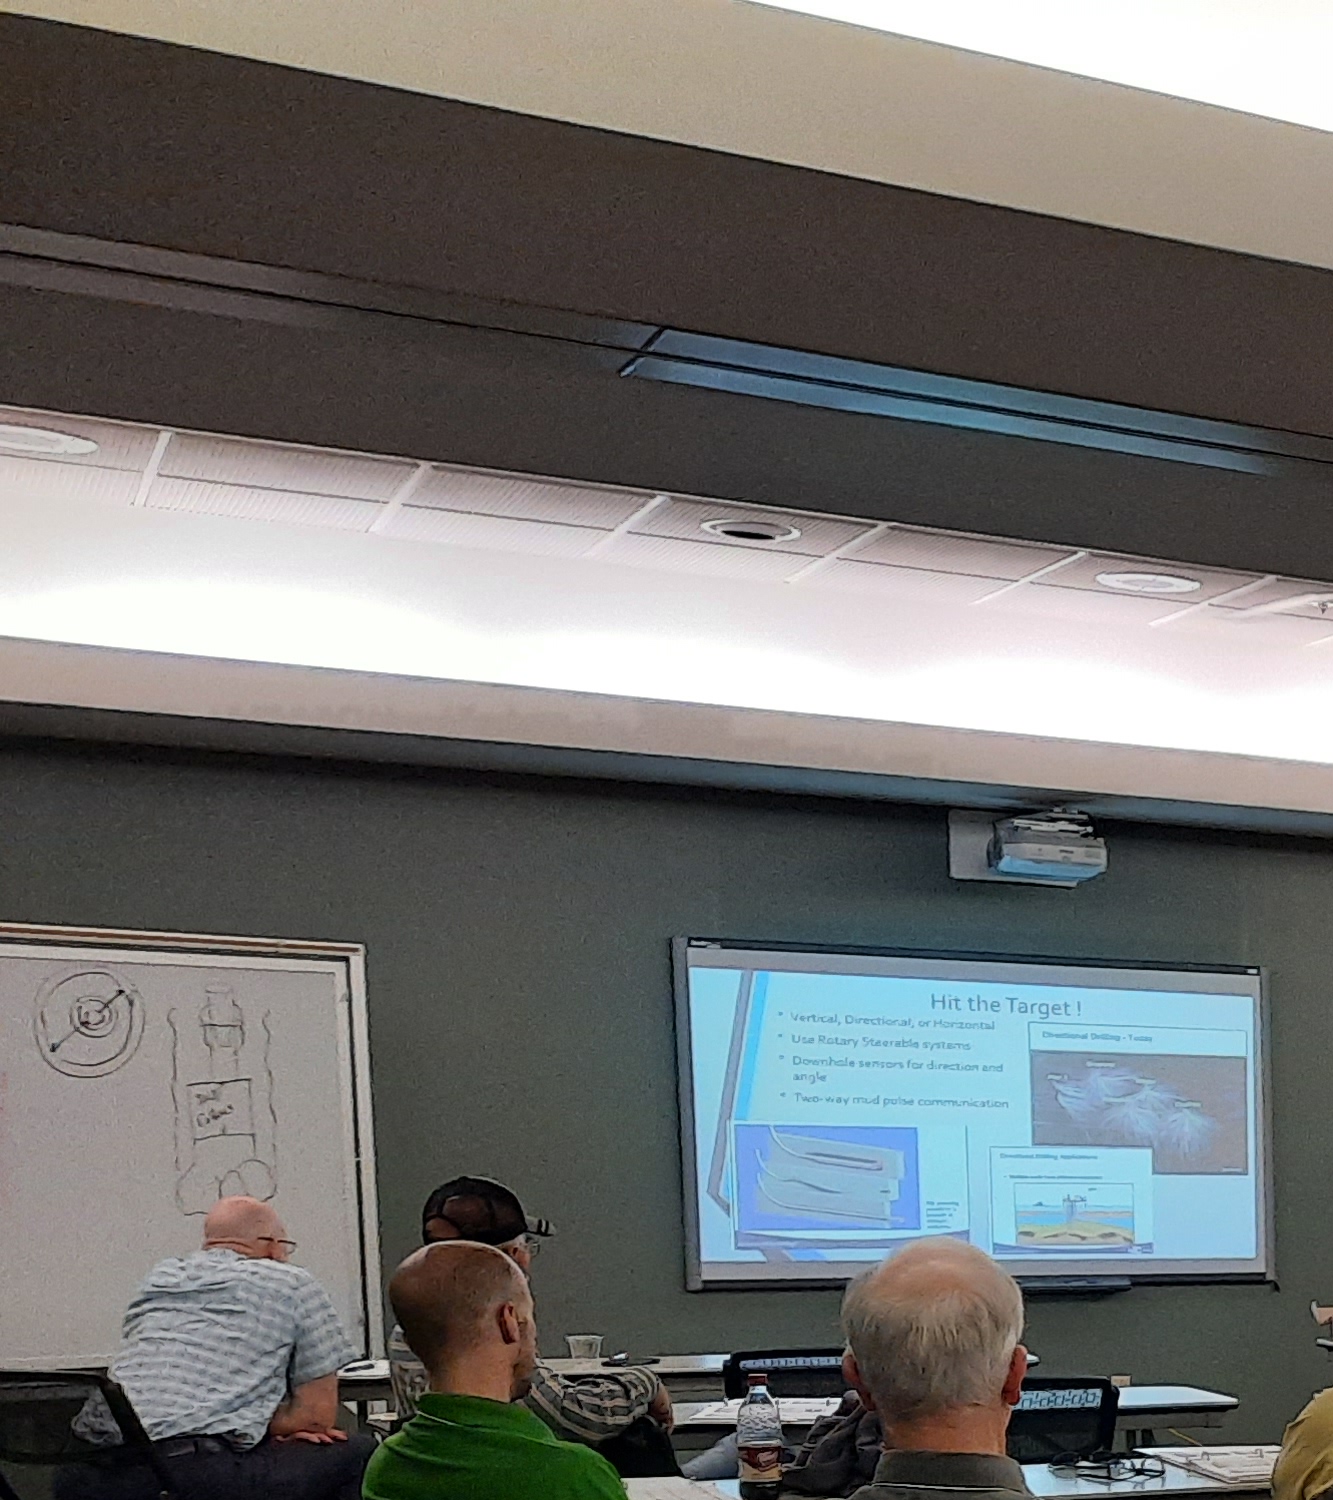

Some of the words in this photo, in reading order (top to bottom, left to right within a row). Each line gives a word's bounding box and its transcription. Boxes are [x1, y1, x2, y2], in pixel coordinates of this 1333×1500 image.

[931, 994, 962, 1012] Hit
[966, 995, 1001, 1013] the
[1005, 996, 1071, 1020] Target
[790, 1011, 841, 1026] Vertical,
[845, 1015, 915, 1029] Directional,
[918, 1020, 931, 1028] or
[933, 1019, 995, 1030] Horizontal
[791, 1034, 815, 1044] Use
[818, 1035, 858, 1048] Rotary
[862, 1036, 919, 1049] Steerable
[792, 1055, 855, 1068] Downhole
[858, 1060, 904, 1070] sensors
[906, 1059, 924, 1070] for
[927, 1060, 979, 1072] direction
[982, 1063, 1004, 1073] and
[792, 1071, 828, 1084] angle
[795, 1092, 849, 1106] Two-way
[852, 1094, 880, 1106] mud
[883, 1096, 914, 1109] pulse
[918, 1098, 1009, 1109] communication
